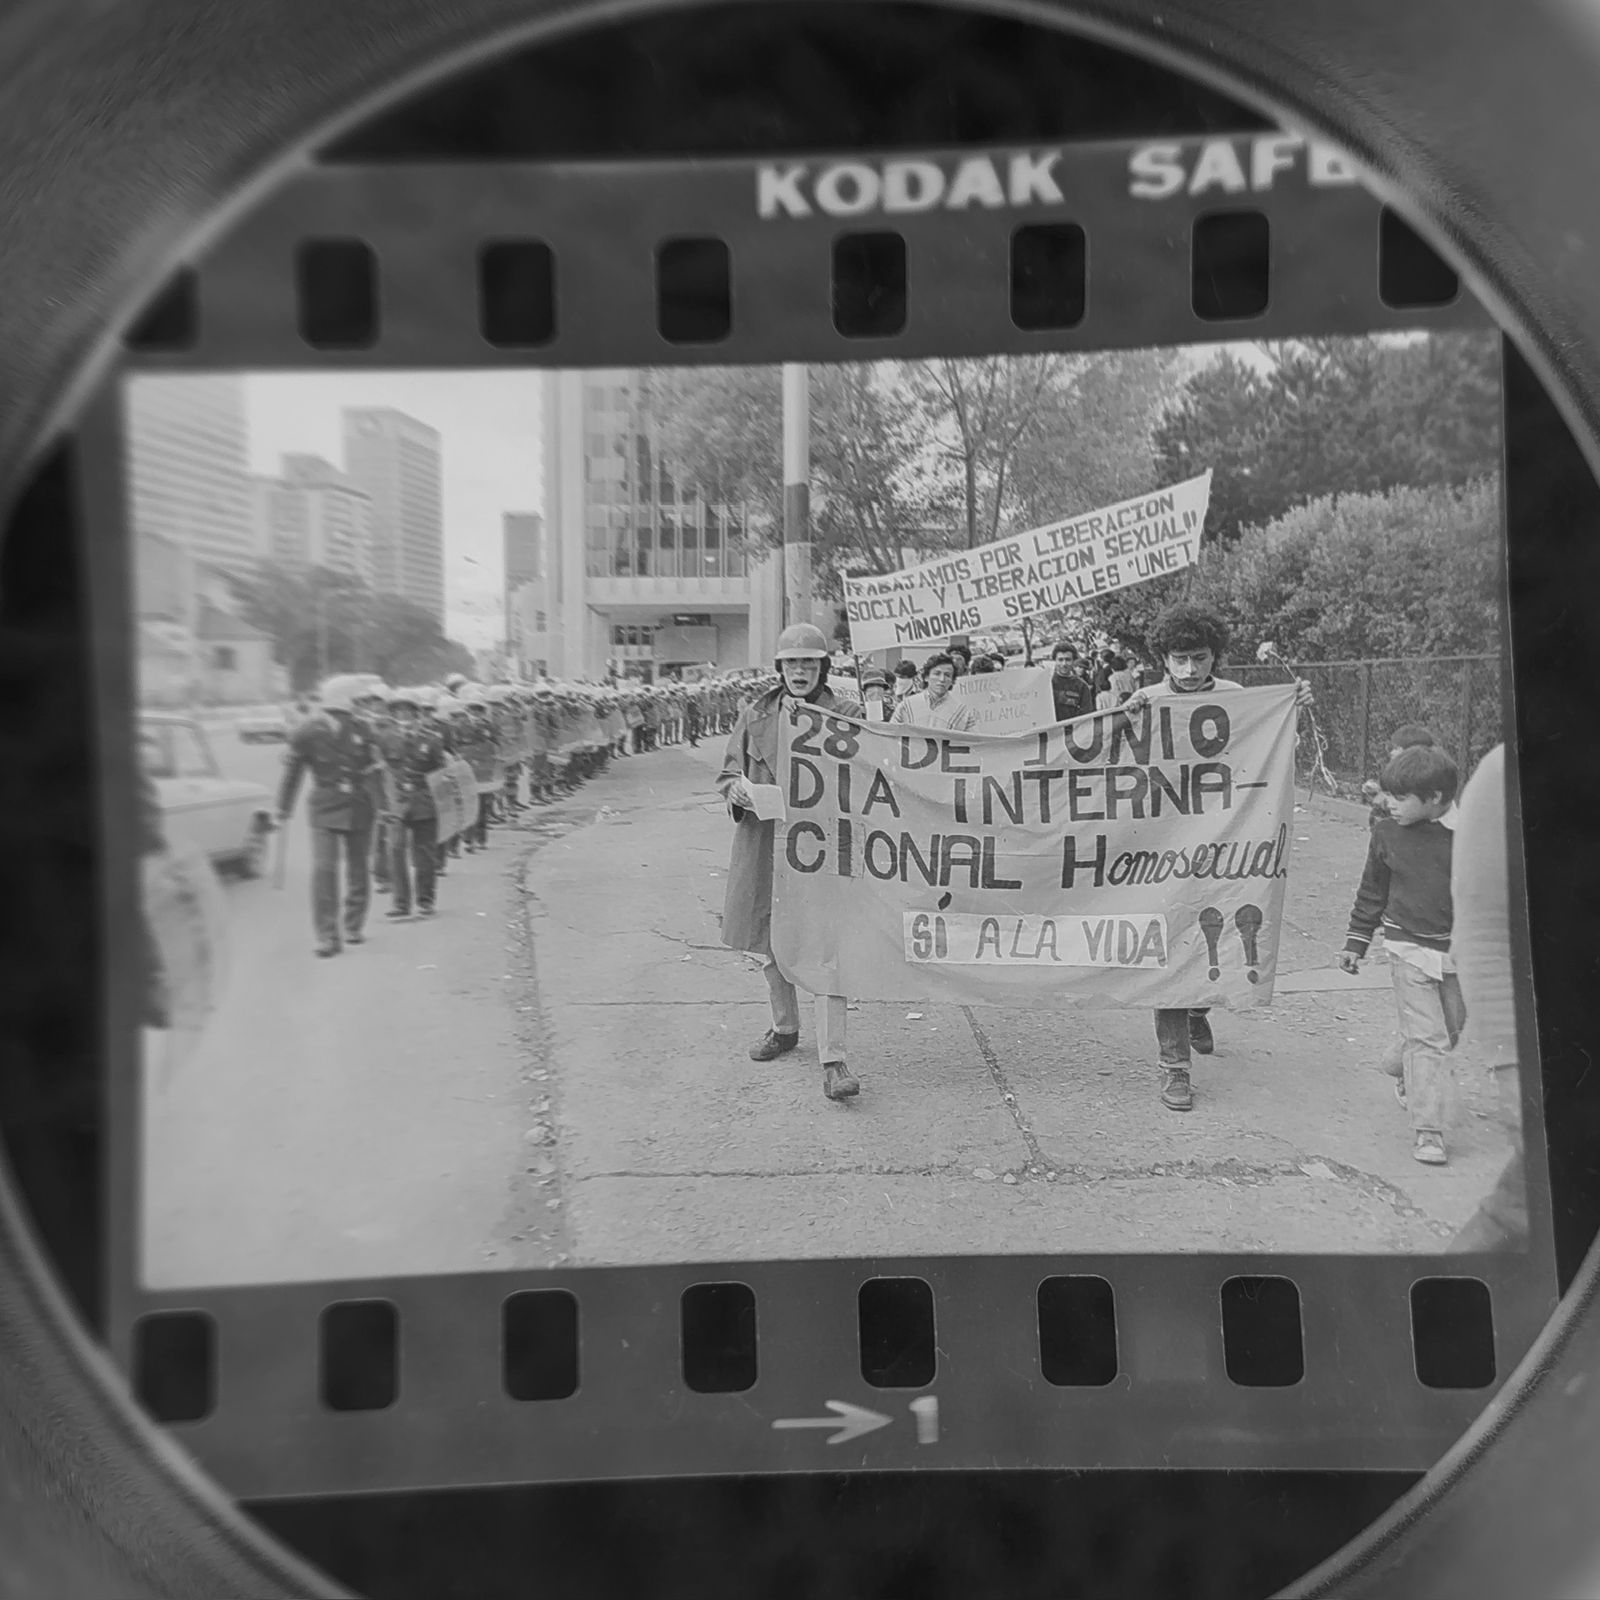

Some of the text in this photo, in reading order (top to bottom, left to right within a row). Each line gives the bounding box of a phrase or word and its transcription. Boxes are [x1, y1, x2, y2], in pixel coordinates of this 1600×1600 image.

[755, 146, 1066, 220] KODAK
[979, 541, 1023, 574] POR
[1033, 493, 1175, 557] LIBERACION
[847, 594, 925, 622] SOCIAL
[932, 586, 946, 609] Y
[957, 545, 1096, 604] LIBERACION
[1002, 564, 1121, 618] SEXUALES
[790, 704, 1231, 774] 28 DE JUNIO
[789, 756, 901, 818] DIA
[786, 818, 1023, 890] CIONAL
[1081, 918, 1169, 968] VIDA
[909, 1395, 939, 1444] 1
